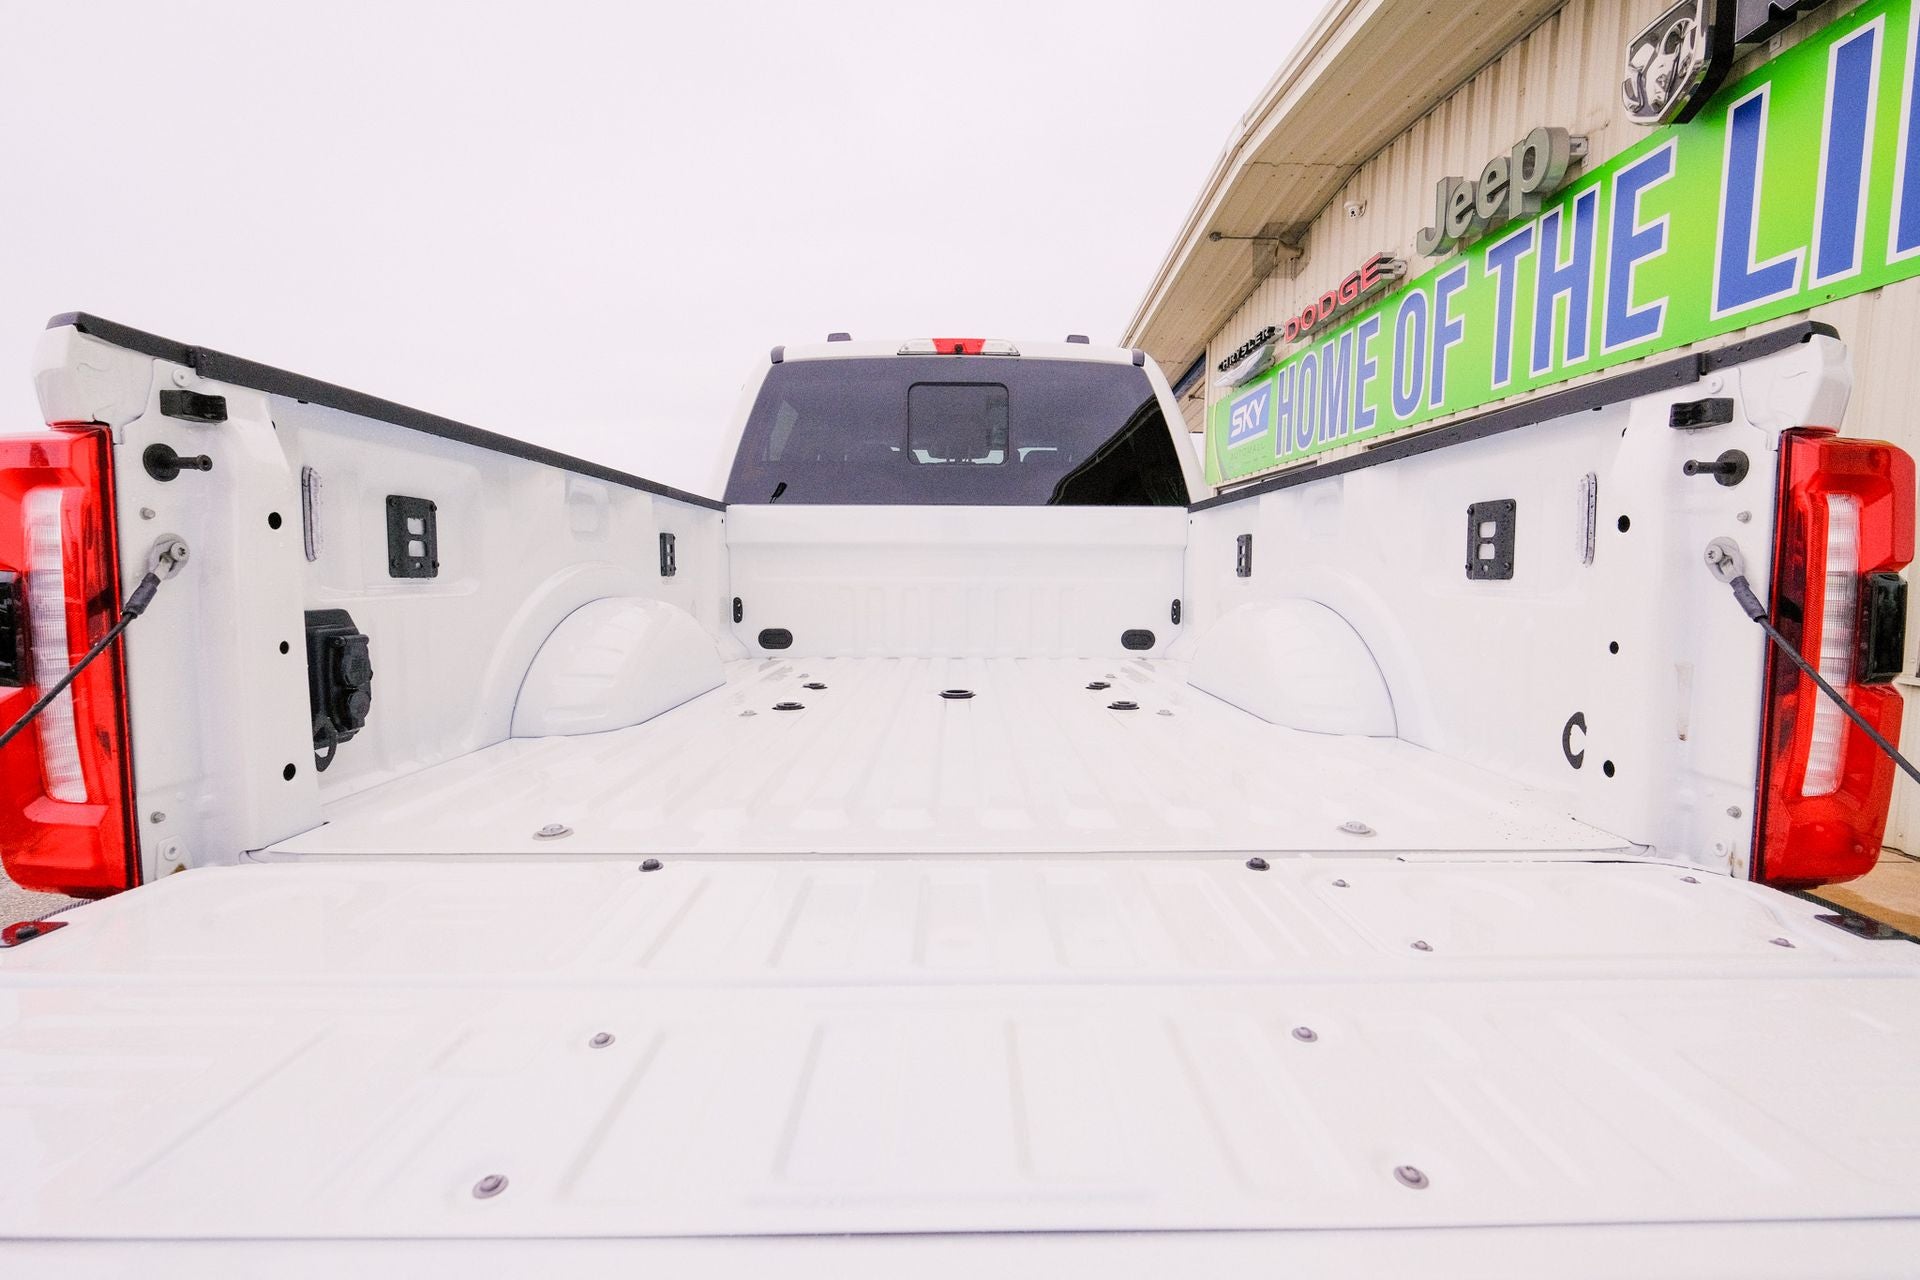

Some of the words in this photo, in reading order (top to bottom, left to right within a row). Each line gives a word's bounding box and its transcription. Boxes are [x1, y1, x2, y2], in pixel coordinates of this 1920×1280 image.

[1416, 127, 1560, 257] Jeep
[1275, 311, 1381, 459] HOME
[1391, 260, 1468, 420] OF
[1484, 135, 1679, 391] THE
[1284, 252, 1390, 344] DODGE
[1230, 393, 1267, 438] SKY
